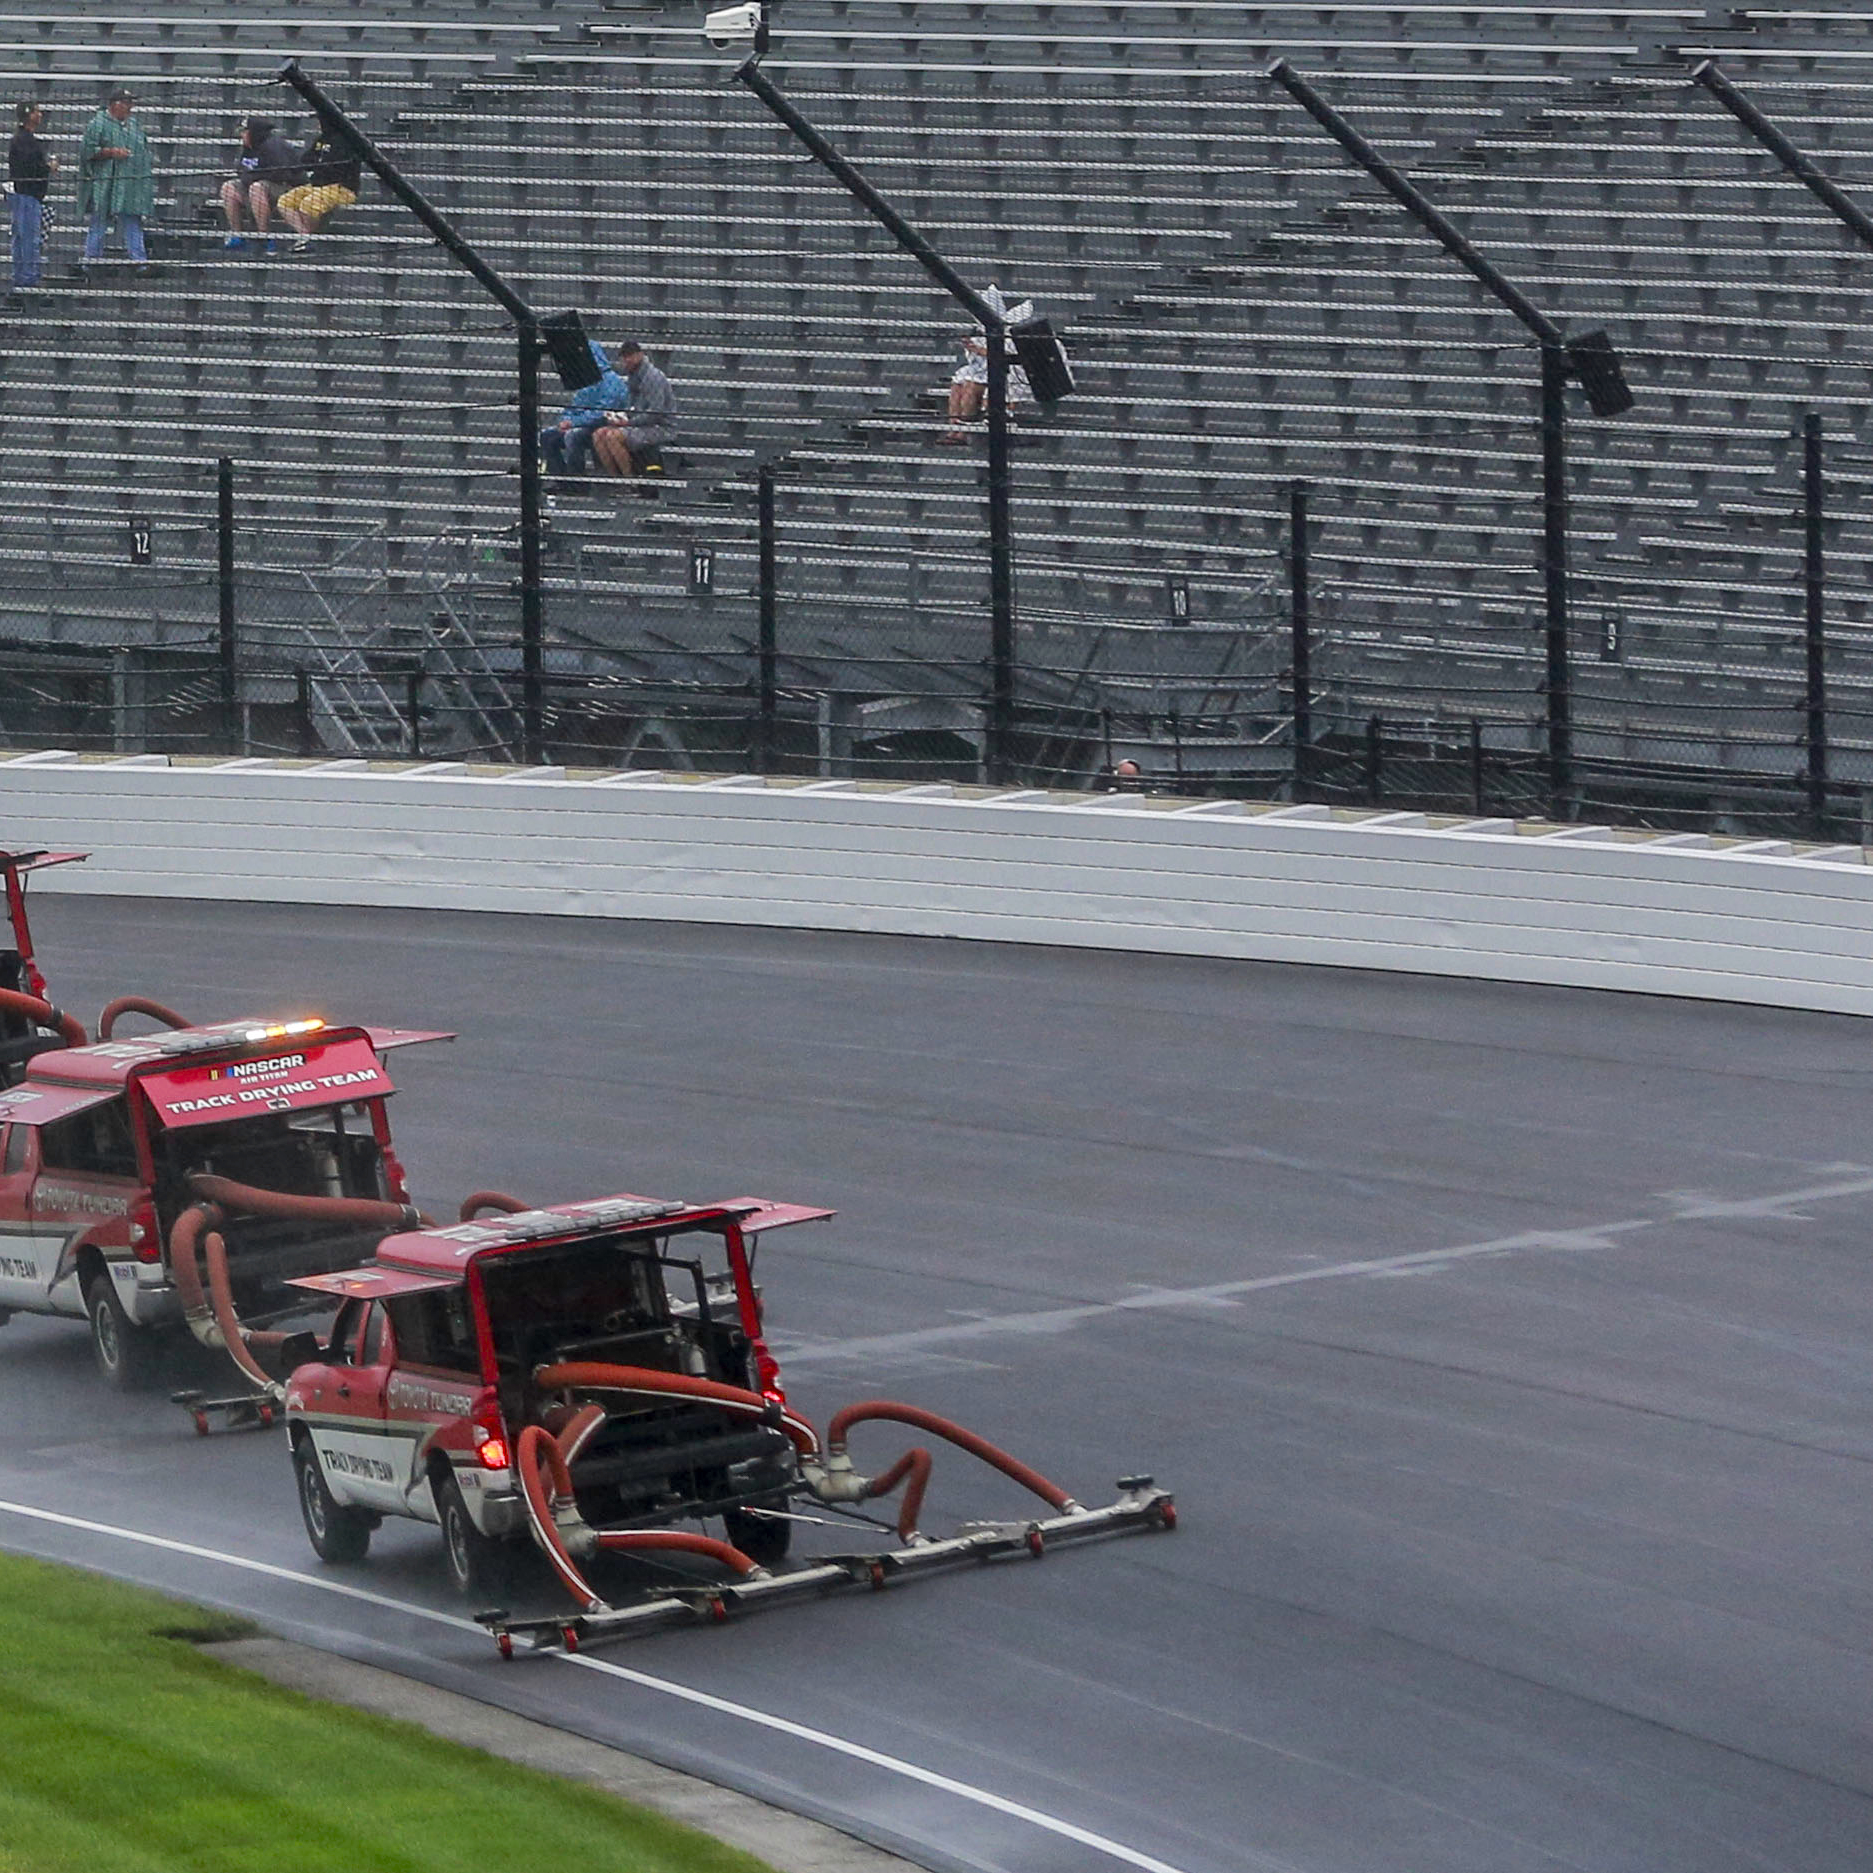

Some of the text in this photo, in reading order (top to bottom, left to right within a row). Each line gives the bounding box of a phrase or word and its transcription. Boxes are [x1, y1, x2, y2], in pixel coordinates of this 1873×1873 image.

[134, 532, 150, 554] 12
[695, 557, 709, 584] 11
[232, 1054, 305, 1077] NASCAR
[240, 1070, 289, 1085] AIR TITAN
[166, 1068, 378, 1114] TRACK DRYING TEAM
[13, 1257, 37, 1279] TEAM
